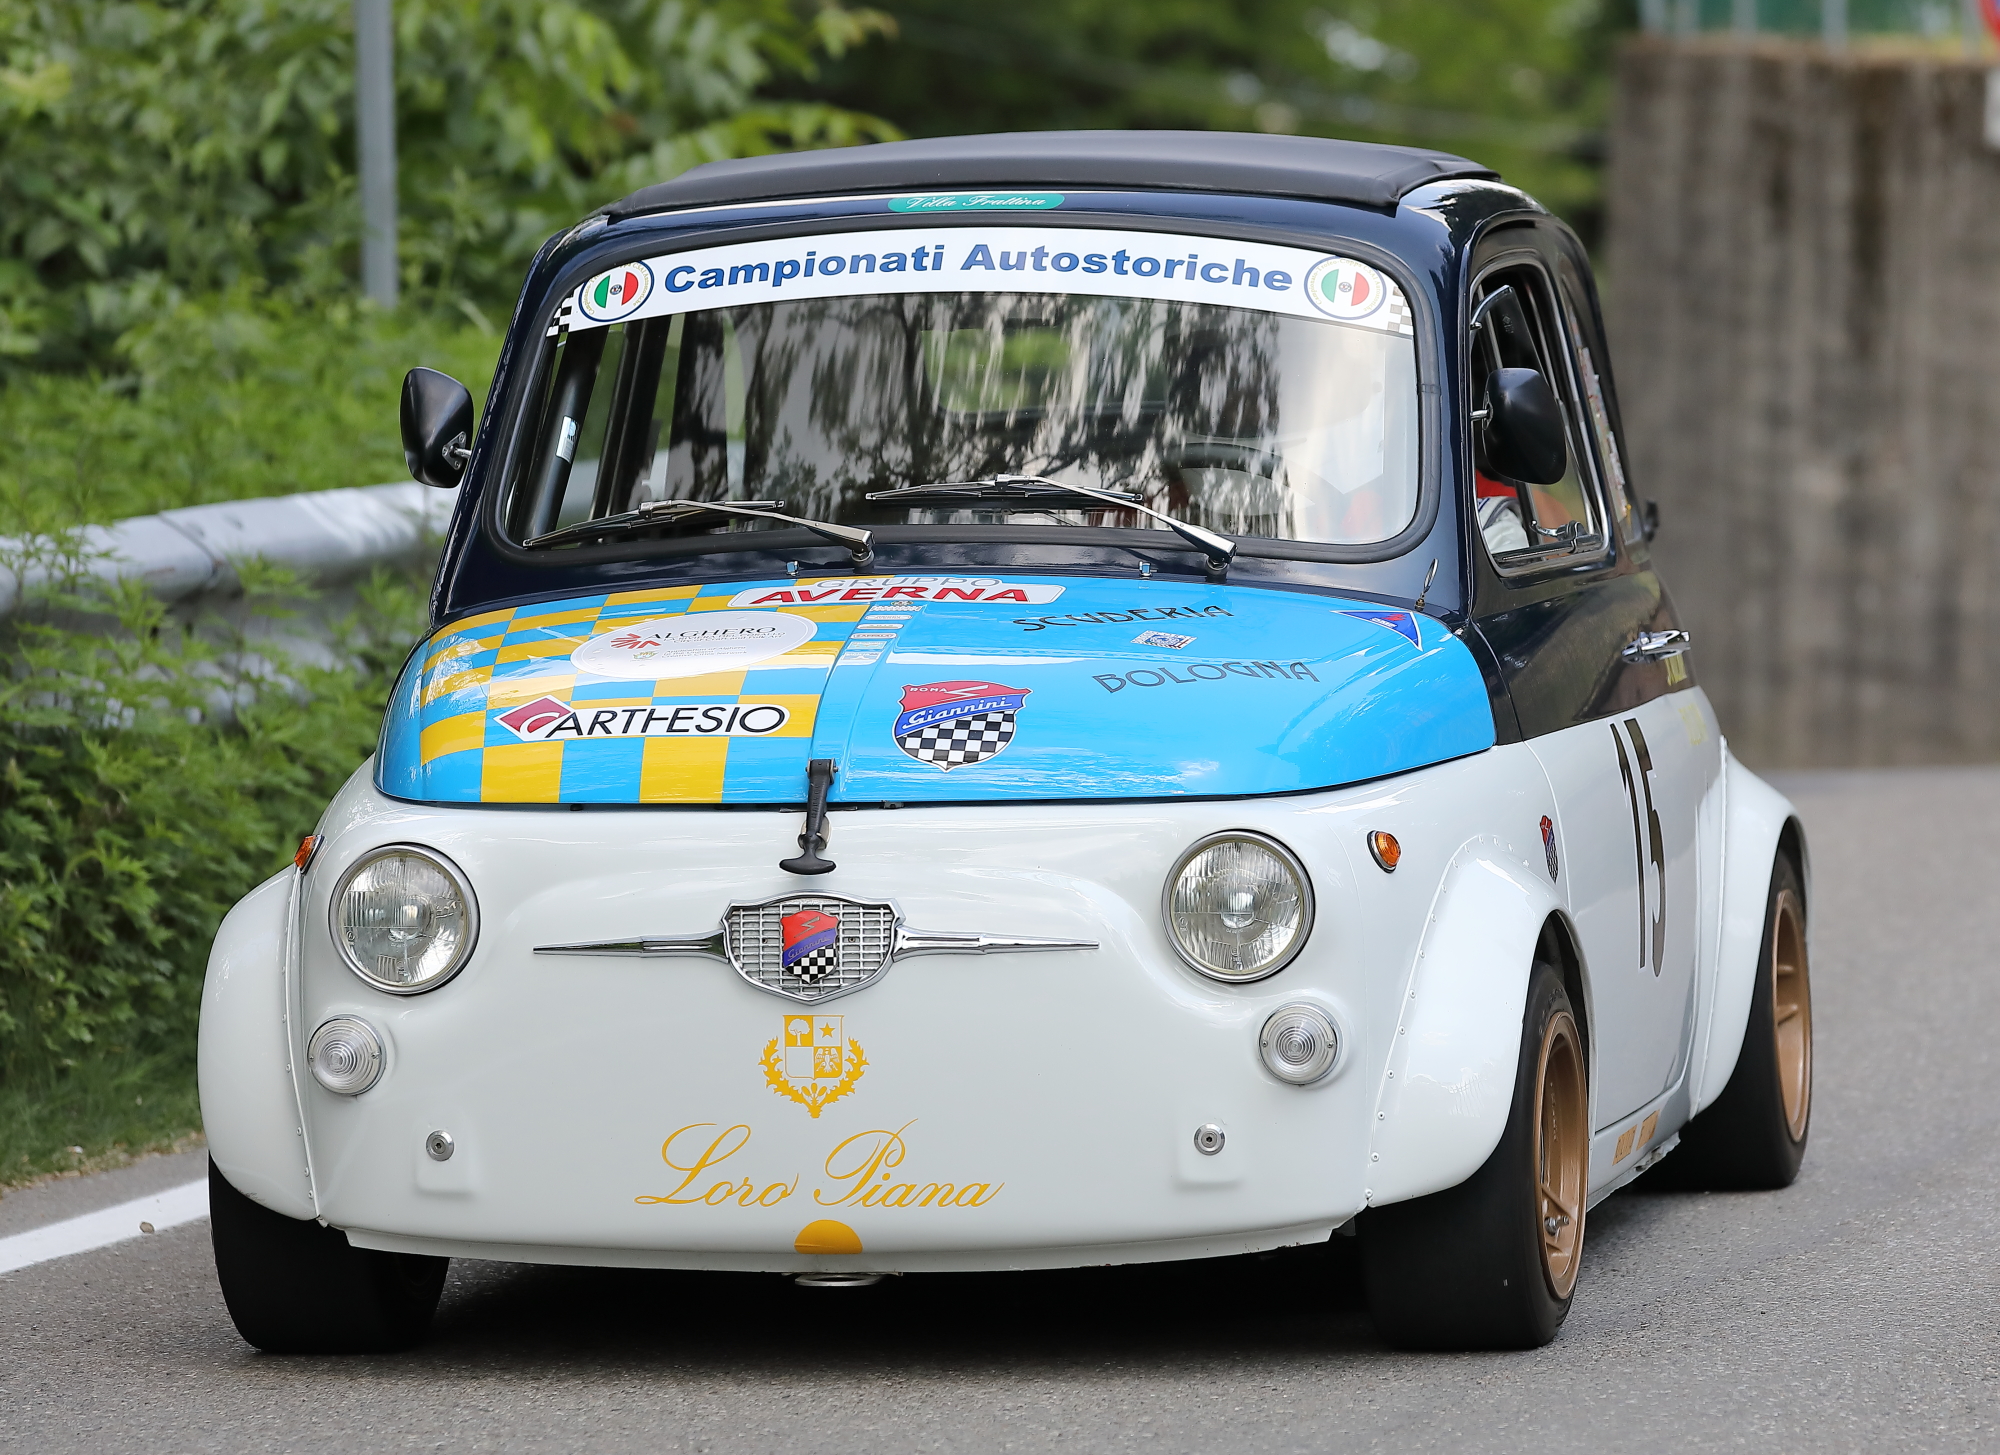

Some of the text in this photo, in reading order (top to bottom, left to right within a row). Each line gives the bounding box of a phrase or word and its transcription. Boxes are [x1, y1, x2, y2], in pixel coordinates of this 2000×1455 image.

[905, 195, 1046, 209] Villa Frattina
[664, 244, 1293, 293] Campionati Autostoriche
[748, 586, 1029, 605] AVERNA
[817, 577, 1000, 588] GRUPPO
[1013, 605, 1234, 631] SCUDERIA
[645, 626, 776, 640] ALGHERO
[1092, 661, 1320, 693] BOLOGNA
[901, 697, 1013, 730] Giannini
[1609, 717, 1667, 978] 15
[787, 935, 831, 962] Giannini
[634, 1118, 1005, 1207] Loro Piana
